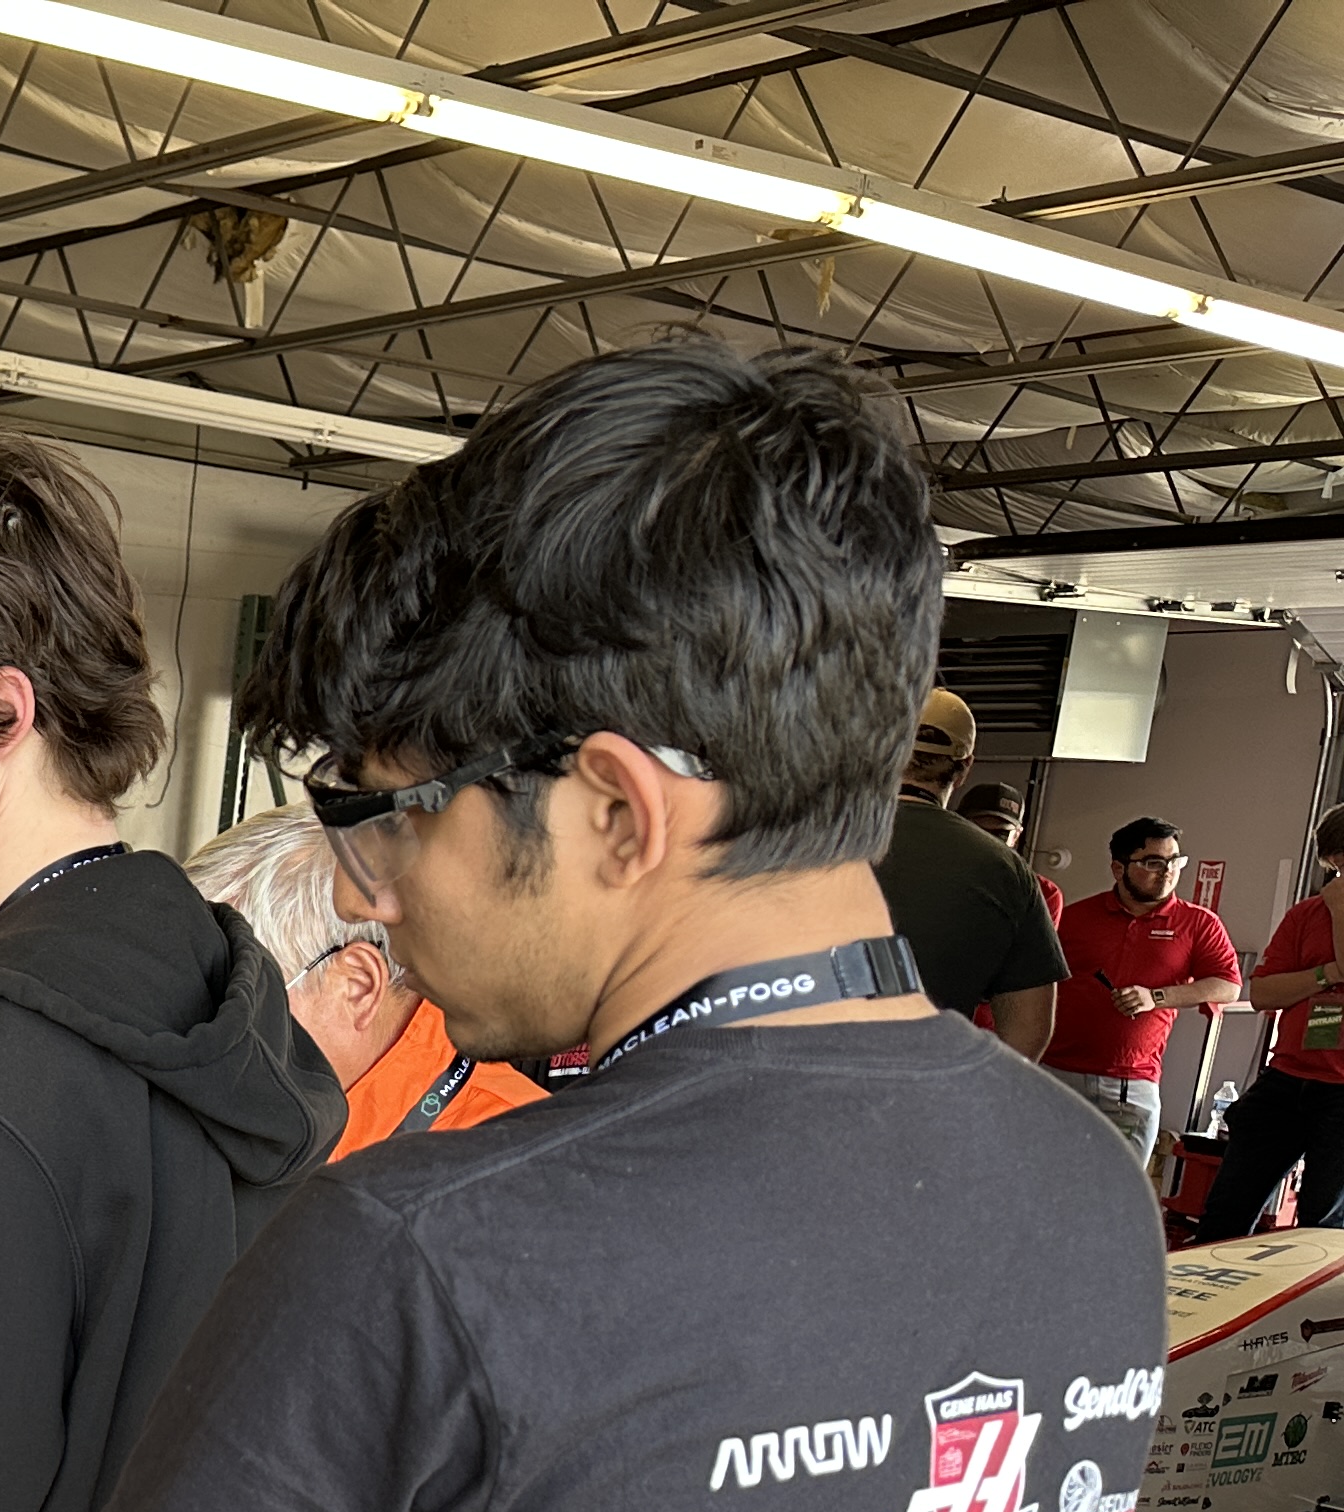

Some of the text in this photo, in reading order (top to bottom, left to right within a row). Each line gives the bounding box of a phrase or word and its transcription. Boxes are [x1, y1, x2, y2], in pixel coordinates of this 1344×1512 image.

[1240, 1331, 1289, 1352] HAYES
[975, 1389, 1014, 1411] HAAS
[710, 1413, 893, 1491] ARROW
[1271, 1449, 1308, 1468] MTEC
